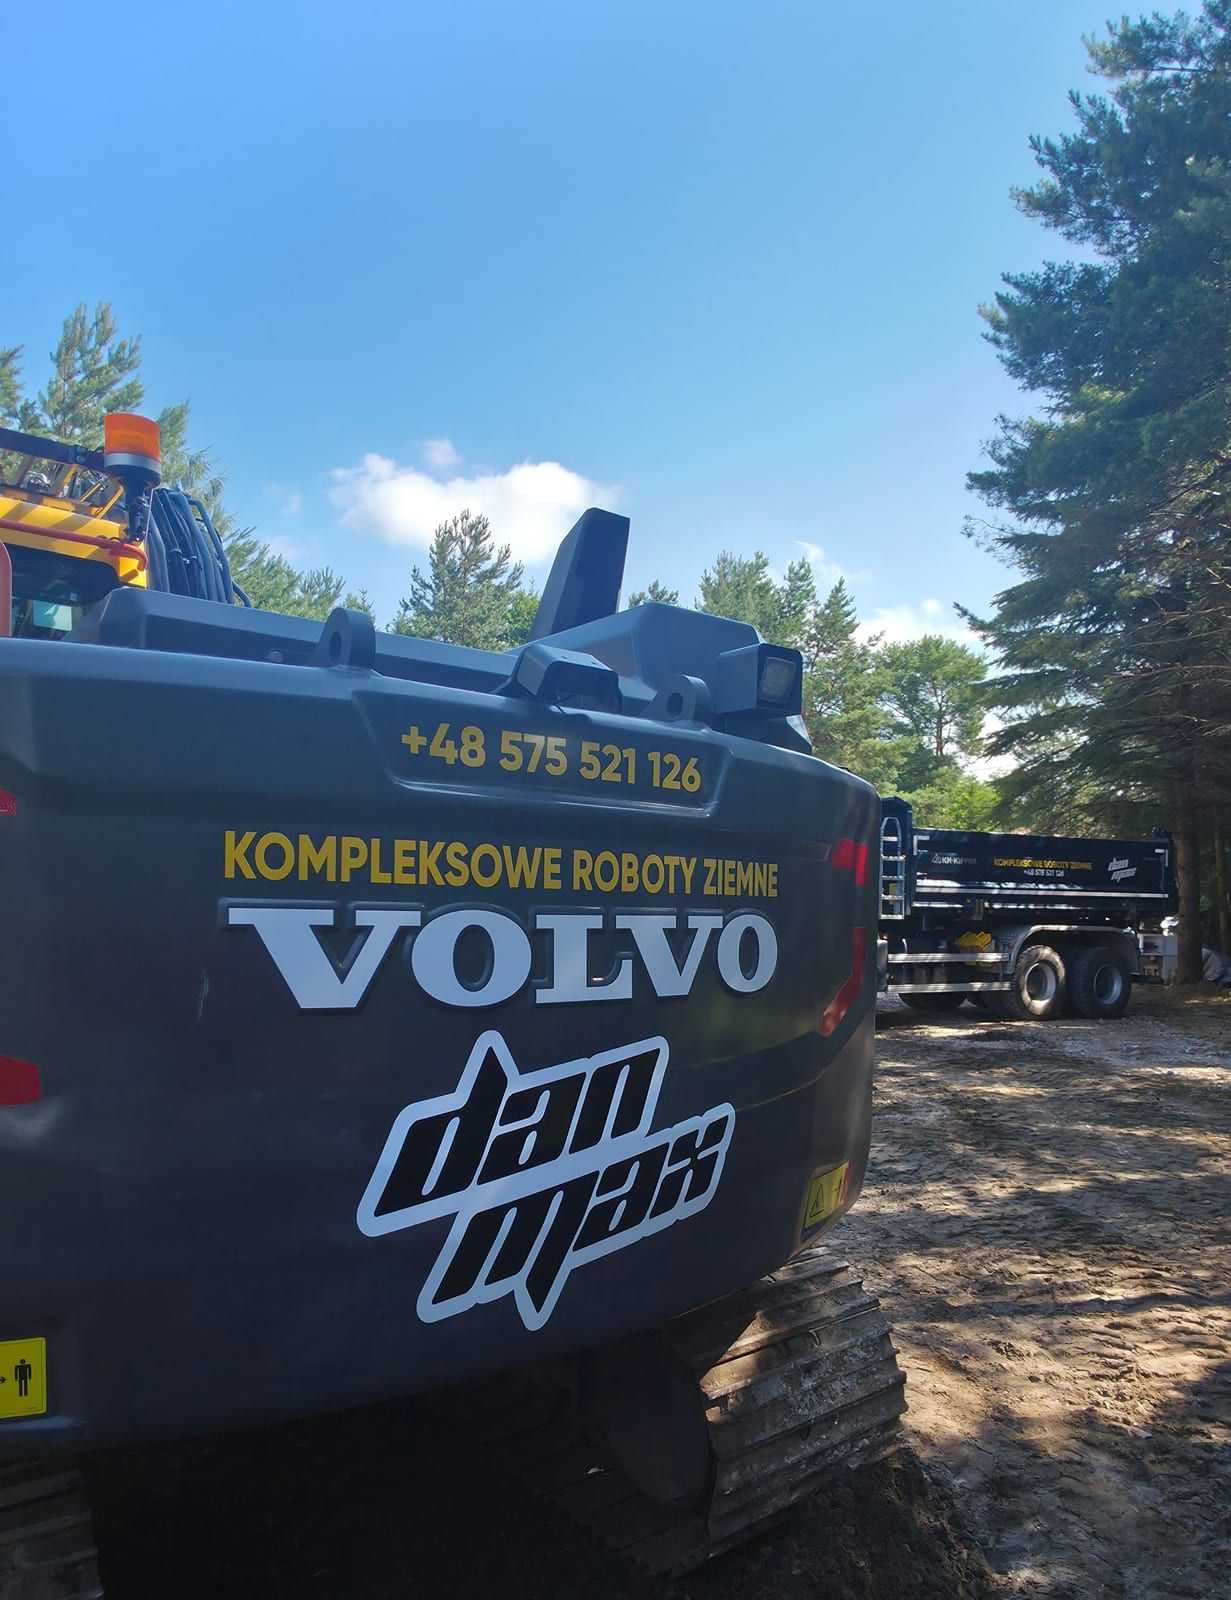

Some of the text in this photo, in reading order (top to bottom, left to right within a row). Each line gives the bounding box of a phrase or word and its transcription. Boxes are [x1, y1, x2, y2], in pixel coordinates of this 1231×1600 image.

[401, 722, 702, 793] +48 575 521 126
[224, 830, 779, 897] KOMPLEKSOWE ROBOTY ZIEMNE
[228, 907, 779, 1010] VOLVO
